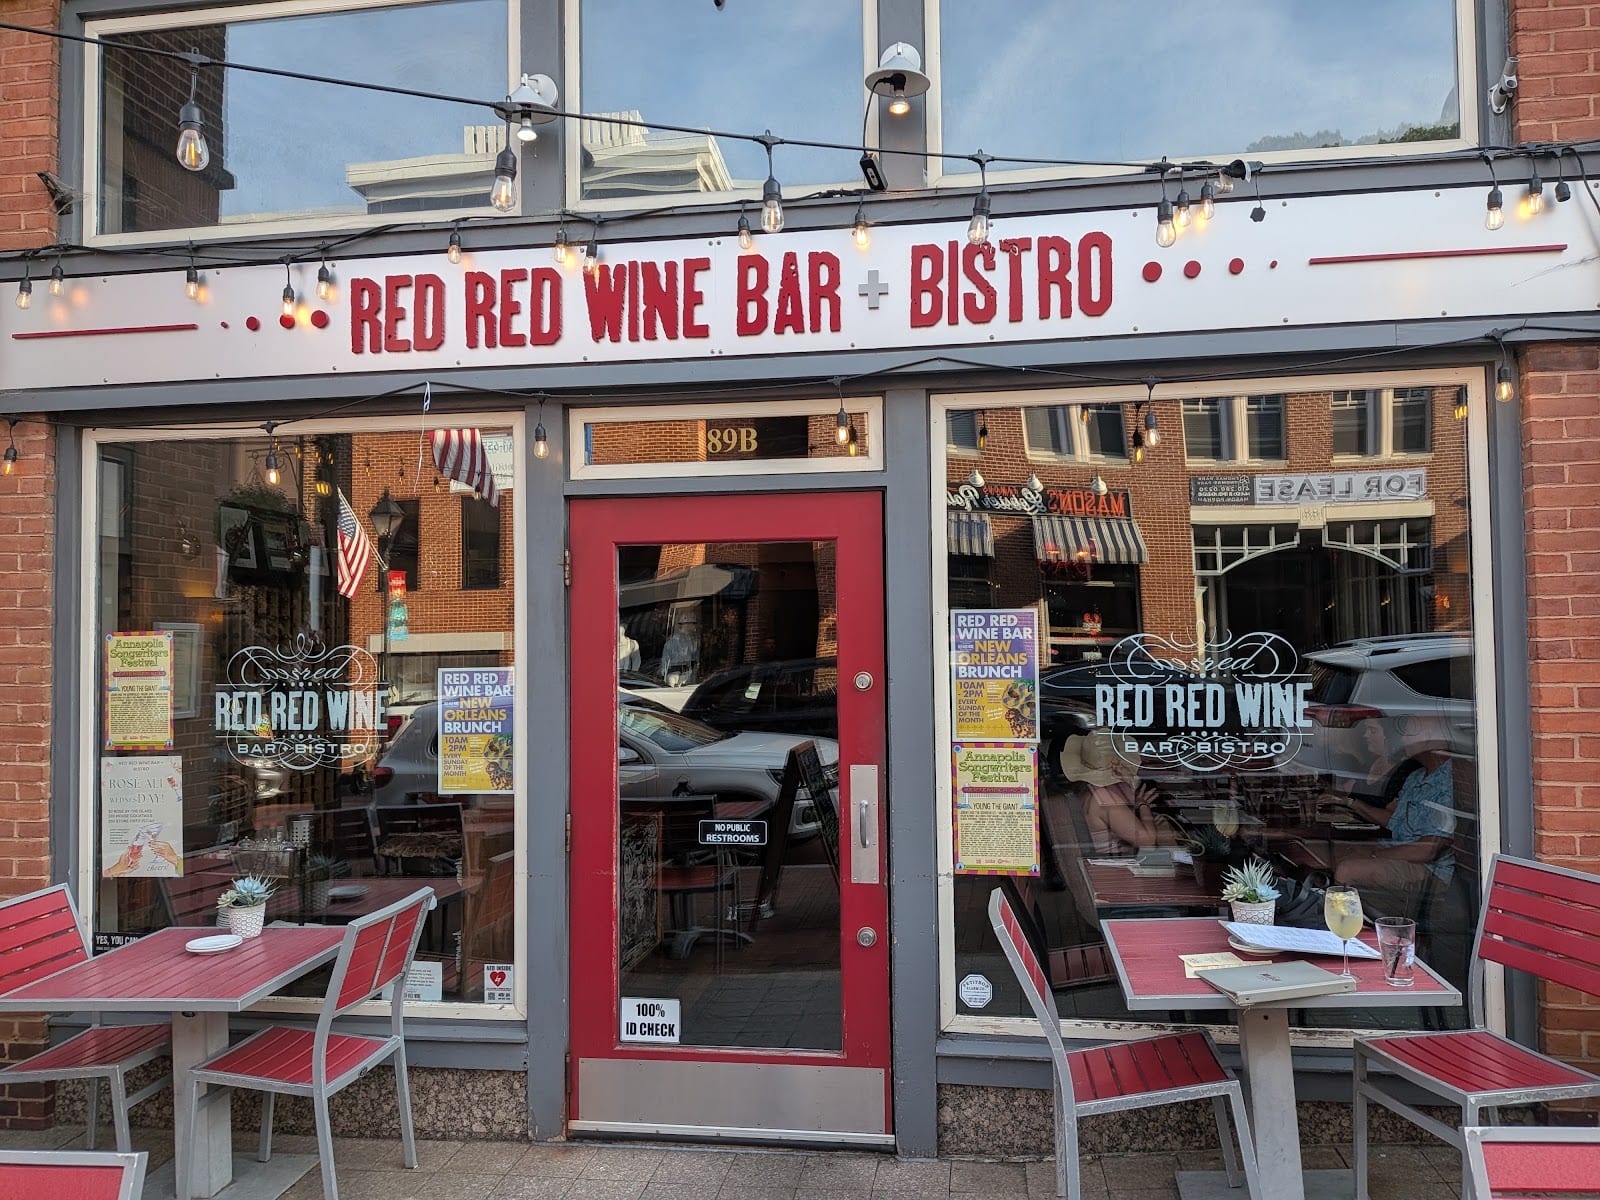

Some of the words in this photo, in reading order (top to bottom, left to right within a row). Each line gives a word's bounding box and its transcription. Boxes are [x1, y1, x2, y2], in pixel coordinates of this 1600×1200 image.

[350, 273, 445, 354] RED
[465, 267, 562, 348] RED
[582, 257, 711, 342] WINE
[737, 251, 841, 336] BAR
[910, 231, 1113, 328] BISTRO
[707, 427, 758, 453] 89B
[957, 614, 985, 627] RED
[989, 614, 1018, 627] RED
[957, 627, 998, 640] WINE
[1003, 627, 1033, 640] BAR
[114, 638, 164, 650] Annapolis
[975, 640, 1011, 652] NEW
[110, 648, 169, 660] Songwriters
[958, 653, 1028, 665] ORLEANS
[119, 657, 158, 667] Festival
[958, 665, 1022, 678] BRUNCH
[444, 673, 470, 685] RED
[473, 672, 499, 685] RED
[443, 685, 483, 697] WINE
[484, 685, 512, 697] BAR
[460, 697, 493, 708] NEW
[1095, 683, 1154, 728] RED
[1166, 683, 1226, 728] RED
[1235, 682, 1313, 728] WINE
[215, 691, 262, 731] RED
[271, 690, 319, 731] RED
[326, 690, 389, 731] WINE
[444, 709, 507, 721] ORLEANS
[444, 722, 502, 733] BRUNCH
[444, 736, 469, 744] 10AM
[237, 743, 276, 754] BAR
[294, 743, 367, 754] BISTRO
[448, 744, 467, 752] 2PM
[1124, 741, 1174, 753] BAR
[1196, 742, 1287, 754] BISTRO
[964, 750, 1026, 764] Annapolis
[959, 761, 1032, 774] Songwriters
[971, 772, 1019, 782] Festival
[714, 823, 726, 832] NO
[726, 823, 751, 832] PUBLIC
[706, 833, 760, 843] RESTROOMS
[95, 935, 110, 945] YES,
[110, 935, 124, 945] YOU
[635, 1003, 666, 1018] 100%
[625, 1022, 637, 1035] ID
[639, 1022, 675, 1037] CHECK
